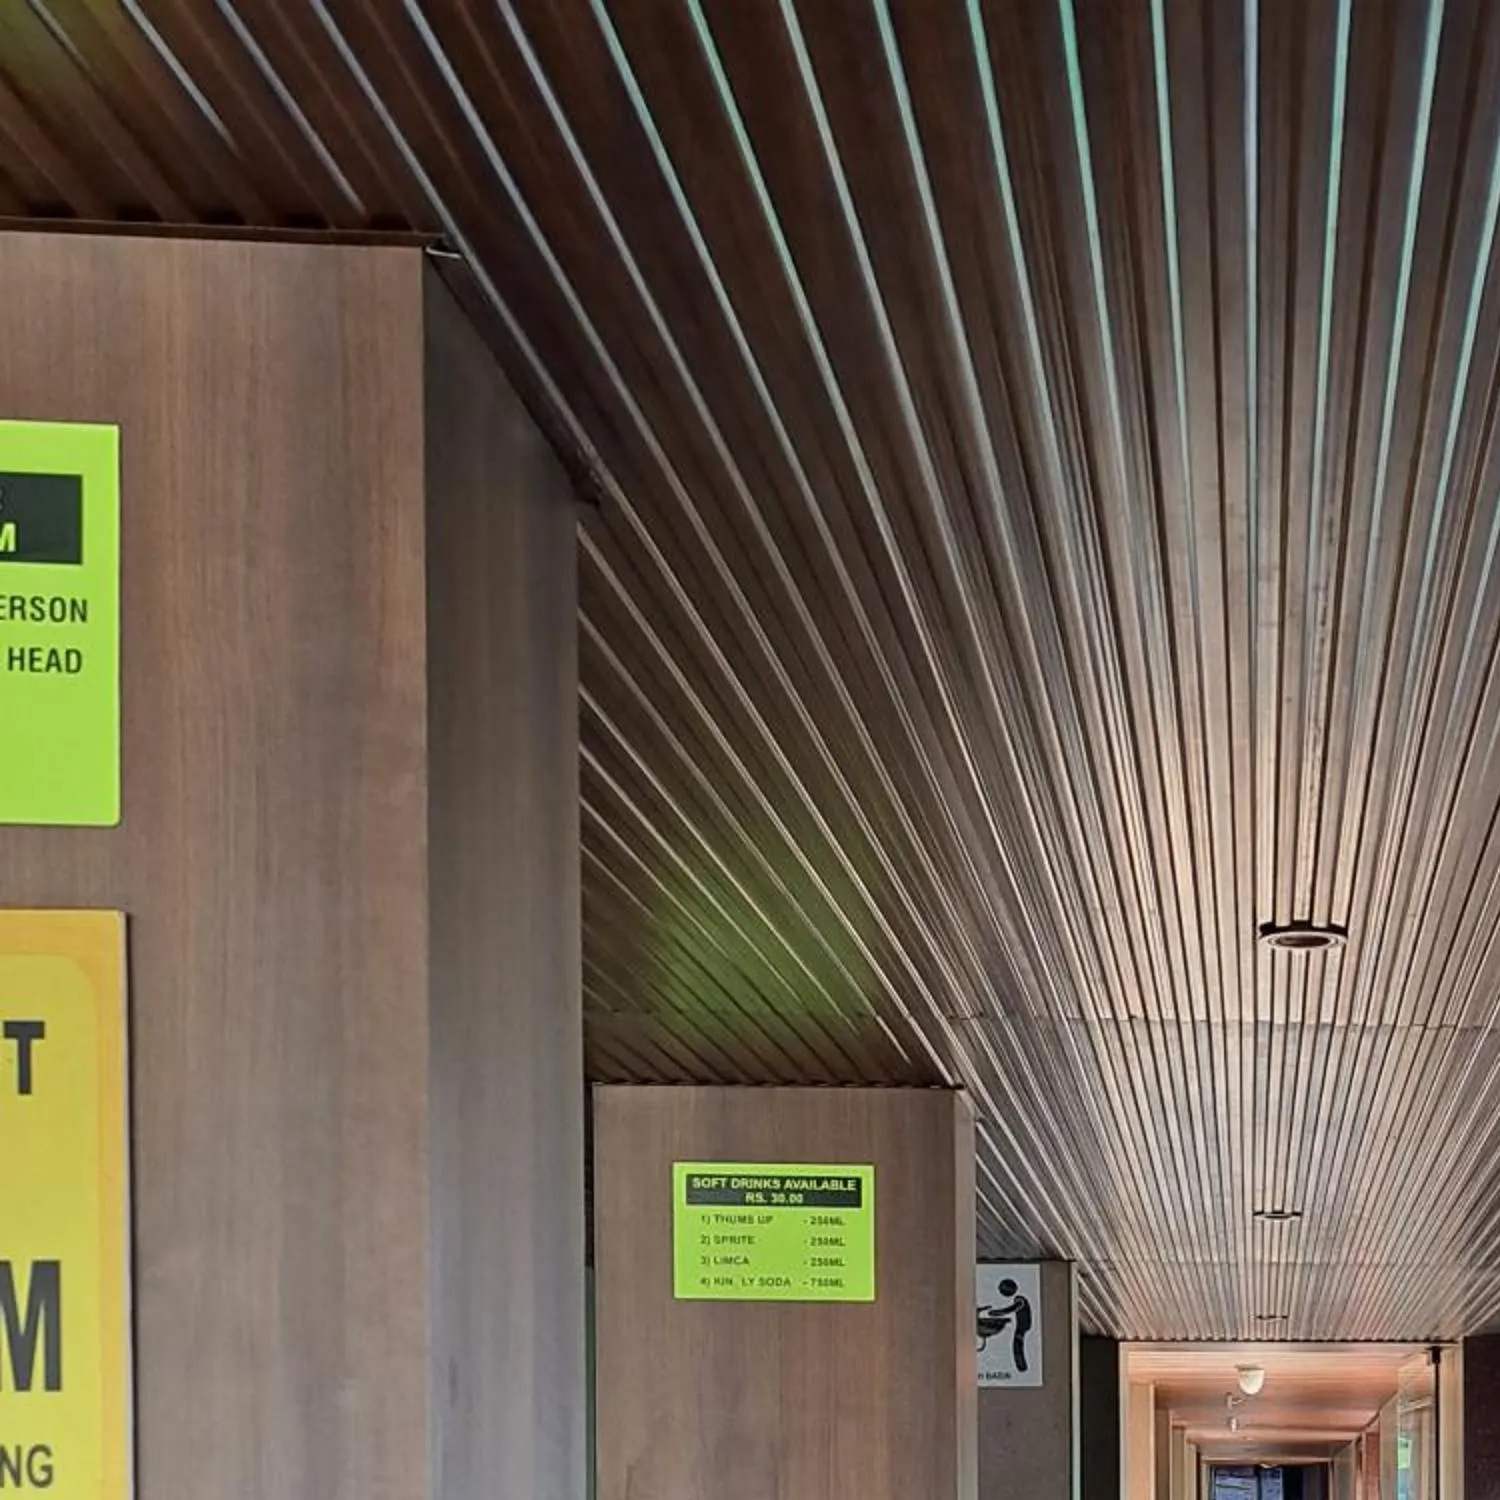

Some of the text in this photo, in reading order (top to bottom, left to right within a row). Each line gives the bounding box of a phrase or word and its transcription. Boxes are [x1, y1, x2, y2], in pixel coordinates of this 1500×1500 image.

[8, 647, 82, 674] HEAD
[3, 1020, 46, 1095] T
[692, 1177, 857, 1191] SOFT DRINKS AVAILABLE
[713, 1235, 756, 1245] SPRITE
[713, 1256, 750, 1265] LIMCA
[758, 1276, 791, 1288] SODA
[0, 1260, 61, 1393] M
[0, 1444, 54, 1488] NG
